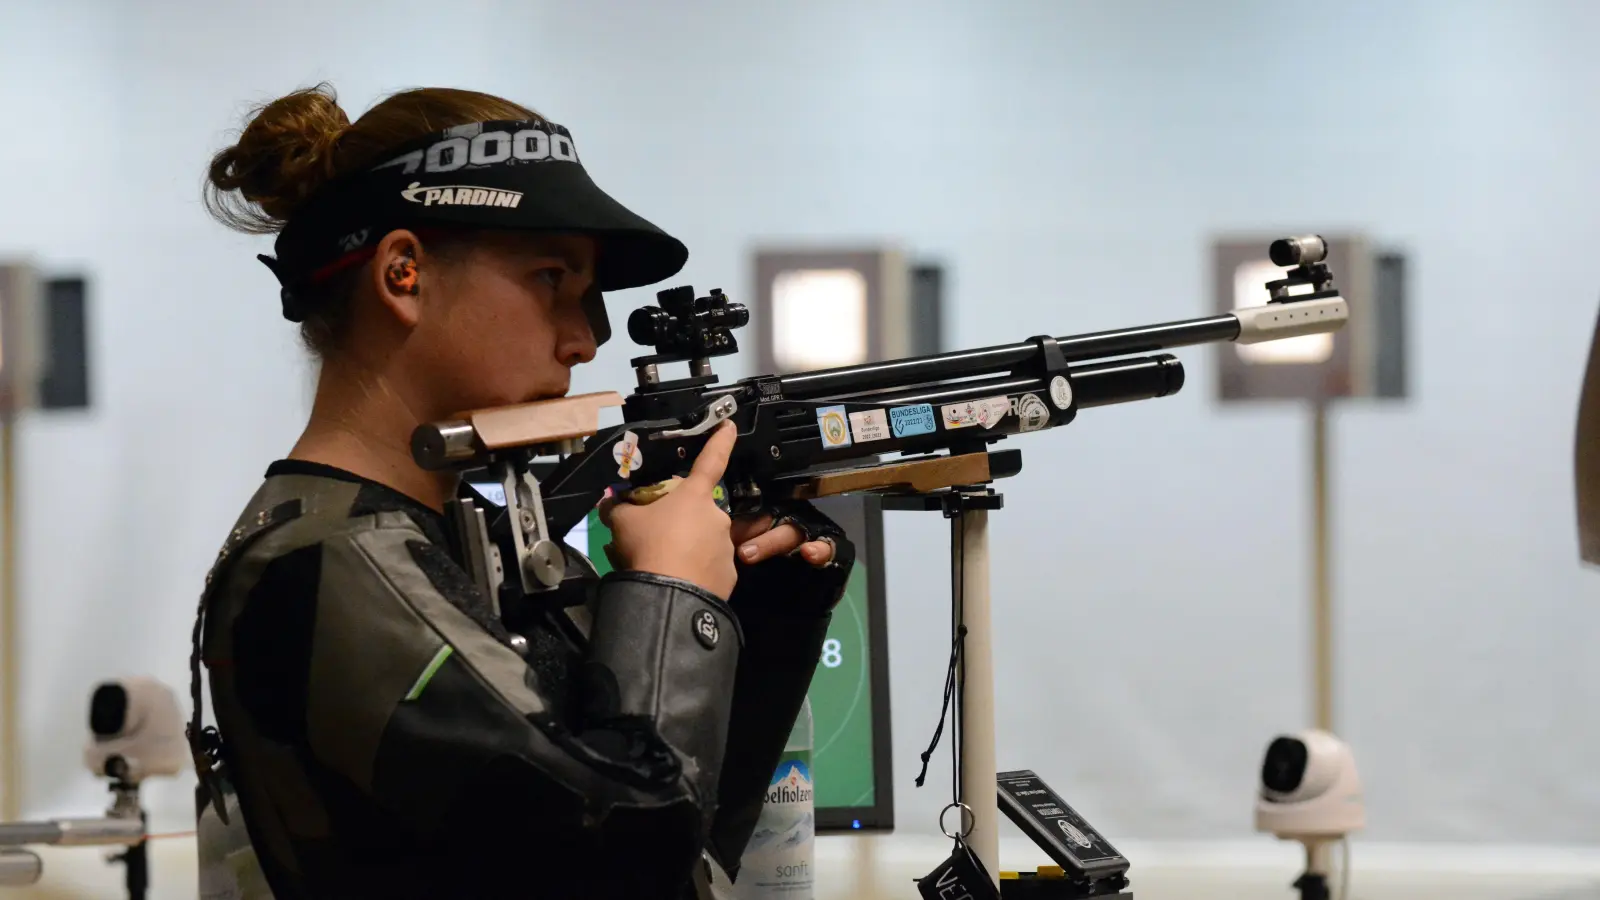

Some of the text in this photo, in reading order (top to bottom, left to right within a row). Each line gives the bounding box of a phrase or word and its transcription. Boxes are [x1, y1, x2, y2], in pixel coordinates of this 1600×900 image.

[423, 188, 523, 209] PARDINI
[891, 406, 931, 419] BUNDESLIGA
[776, 860, 809, 878] sanft
